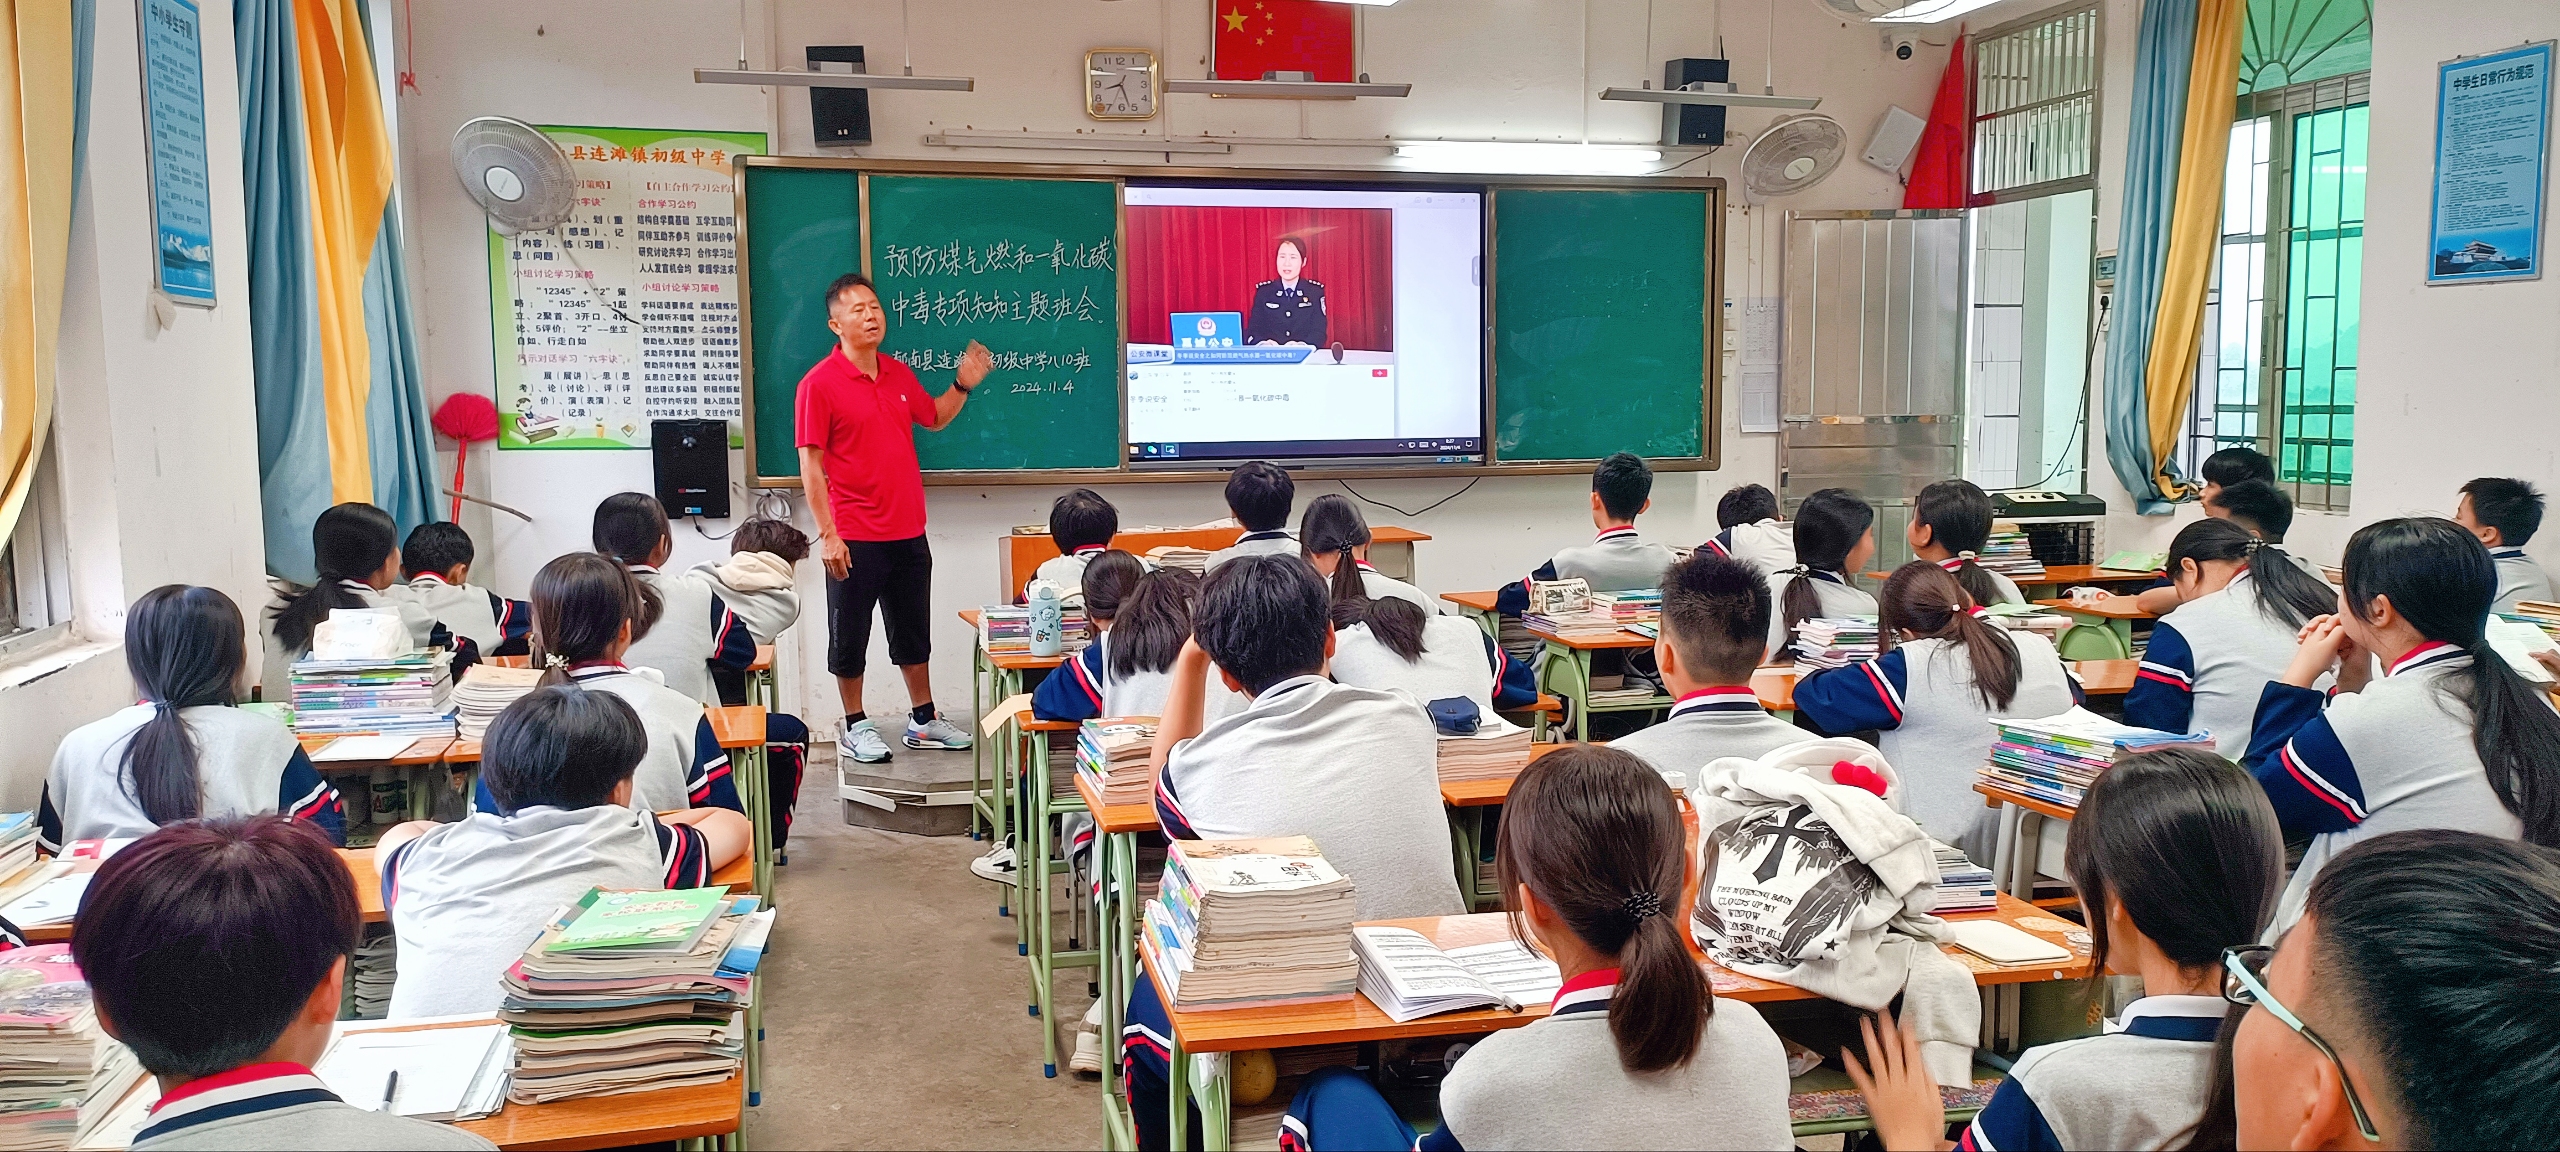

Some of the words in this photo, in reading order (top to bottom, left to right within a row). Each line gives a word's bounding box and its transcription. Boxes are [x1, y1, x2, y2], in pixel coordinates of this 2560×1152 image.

[1104, 57, 1111, 65] 11
[1116, 57, 1125, 65] 12
[1131, 57, 1135, 65] 1
[2453, 64, 2534, 91] 中学生日常行为规范
[1094, 80, 1101, 89] 9
[1140, 80, 1147, 89] 3
[1095, 94, 1102, 103] 8
[1141, 94, 1148, 102] 4
[1105, 103, 1113, 112] 7
[1118, 103, 1126, 112] 6
[1131, 103, 1138, 112] 5
[561, 144, 726, 165] 县连滩镇初级中学
[638, 199, 697, 209] 合作学习公约
[696, 216, 735, 227] 互学互助同
[697, 231, 736, 243] 训练评价争
[638, 247, 691, 258] 研究讨论共学习
[697, 247, 736, 259] 合作学习出
[884, 236, 1114, 278] 预防煤气燃和一氧化碳
[639, 263, 692, 274] 人人发言机会均
[513, 269, 594, 279] 小组讨论学习策略
[642, 283, 720, 293] 小组讨论学习策略
[1130, 350, 1169, 358] 公安微课堂
[1010, 380, 1075, 395] 2024.11.4
[1717, 885, 1733, 893] THE
[1763, 903, 1778, 914] MY
